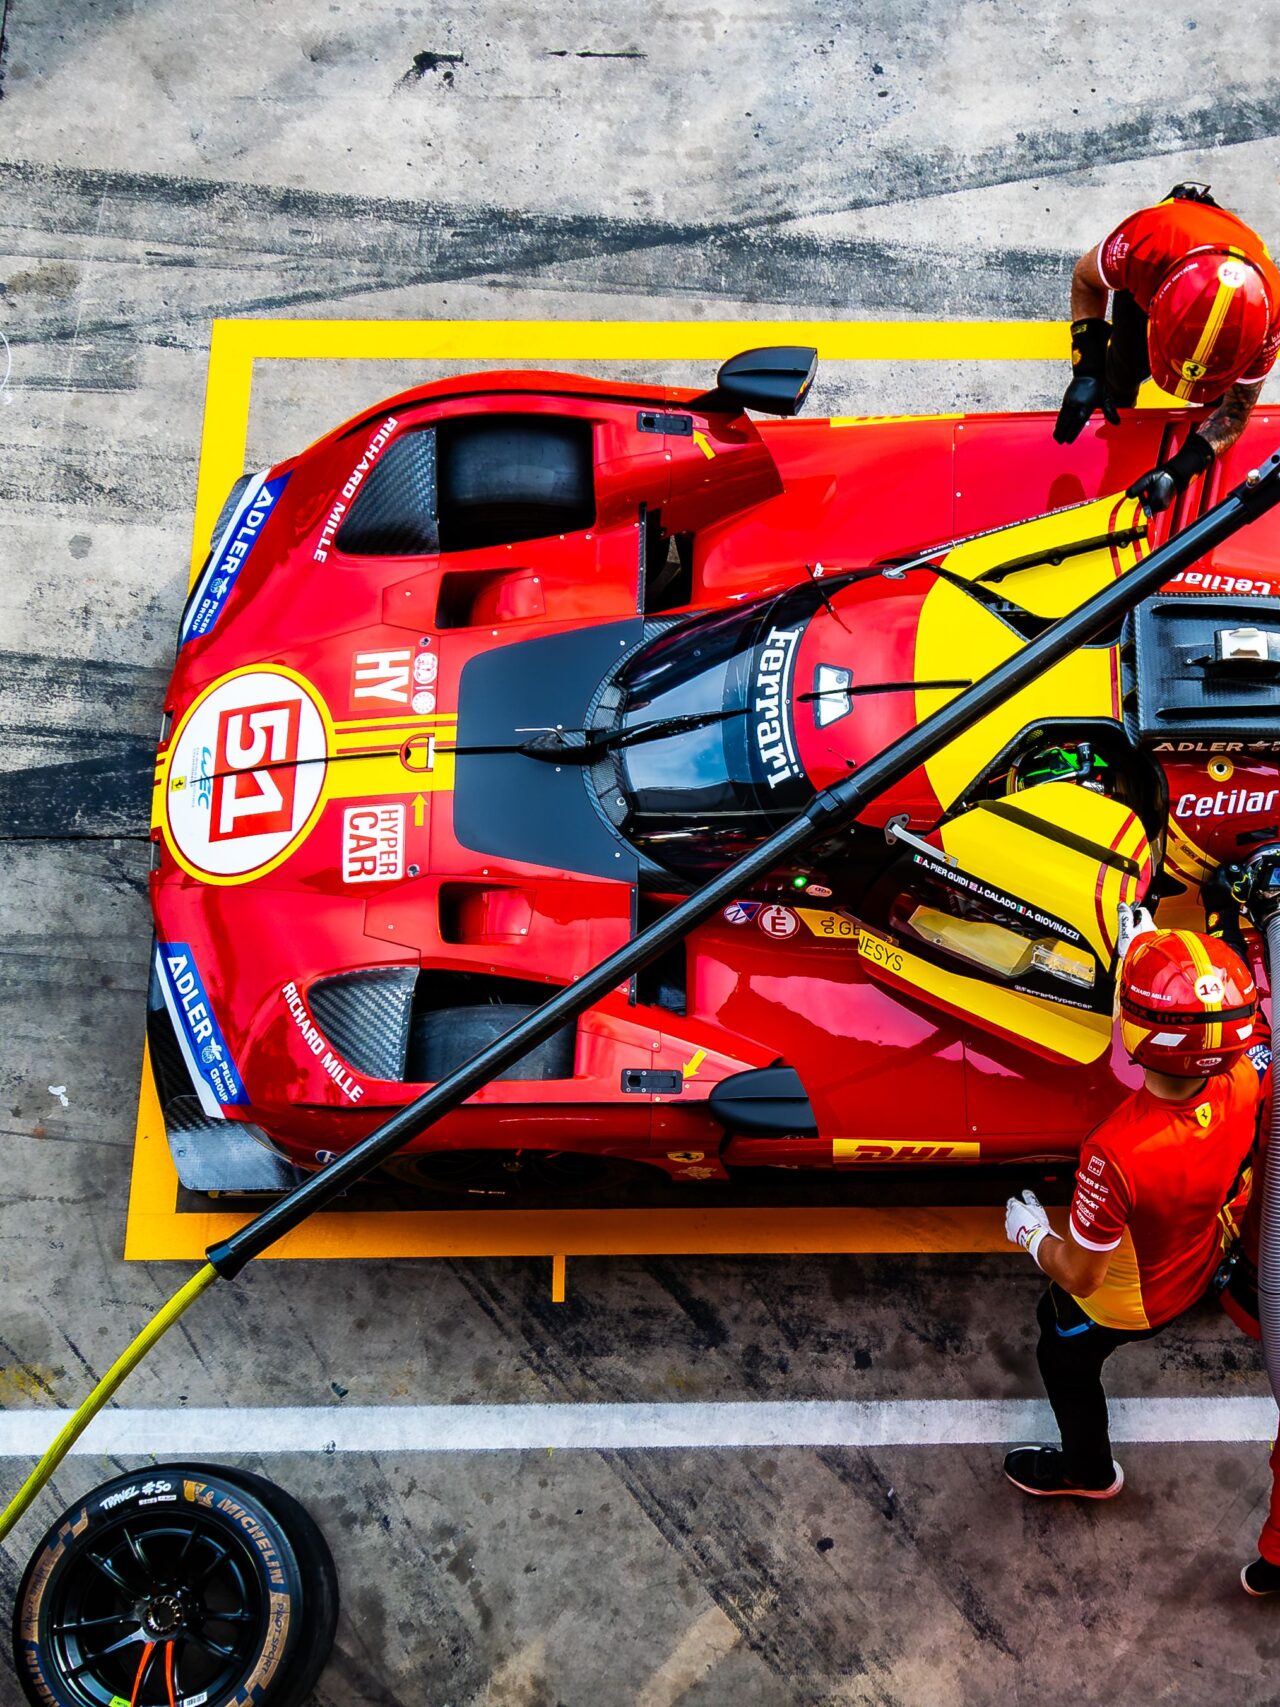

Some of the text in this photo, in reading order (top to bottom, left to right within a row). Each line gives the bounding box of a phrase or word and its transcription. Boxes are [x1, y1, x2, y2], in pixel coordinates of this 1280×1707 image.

[312, 416, 399, 564] RICHARD MILLE
[198, 485, 274, 634] ADLER PELZER
[1170, 571, 1271, 595] Cetilar
[191, 598, 212, 632] GROUP
[353, 650, 411, 704] HY
[755, 625, 800, 790] Ferrari
[218, 707, 291, 835] 51
[1151, 742, 1244, 752] ADLER
[1175, 788, 1279, 818] Cetilar
[347, 811, 378, 879] CAR
[378, 808, 399, 876] HYPER
[930, 862, 948, 878] PIER
[947, 871, 969, 888] GUIDI
[984, 889, 1017, 911] CALADO
[1034, 914, 1080, 941] GIOVINAZZI
[1151, 992, 1172, 1001] MILLE
[1198, 983, 1222, 996] 14
[168, 954, 238, 1097] ADLER PELZER
[282, 981, 365, 1103] RICHARD MILLE
[209, 1066, 230, 1103] GROUP
[852, 1145, 956, 1161] DHL
[99, 1485, 140, 1510] TRAVEL
[141, 1480, 172, 1496] #50
[216, 1496, 285, 1585] MICHELIN
